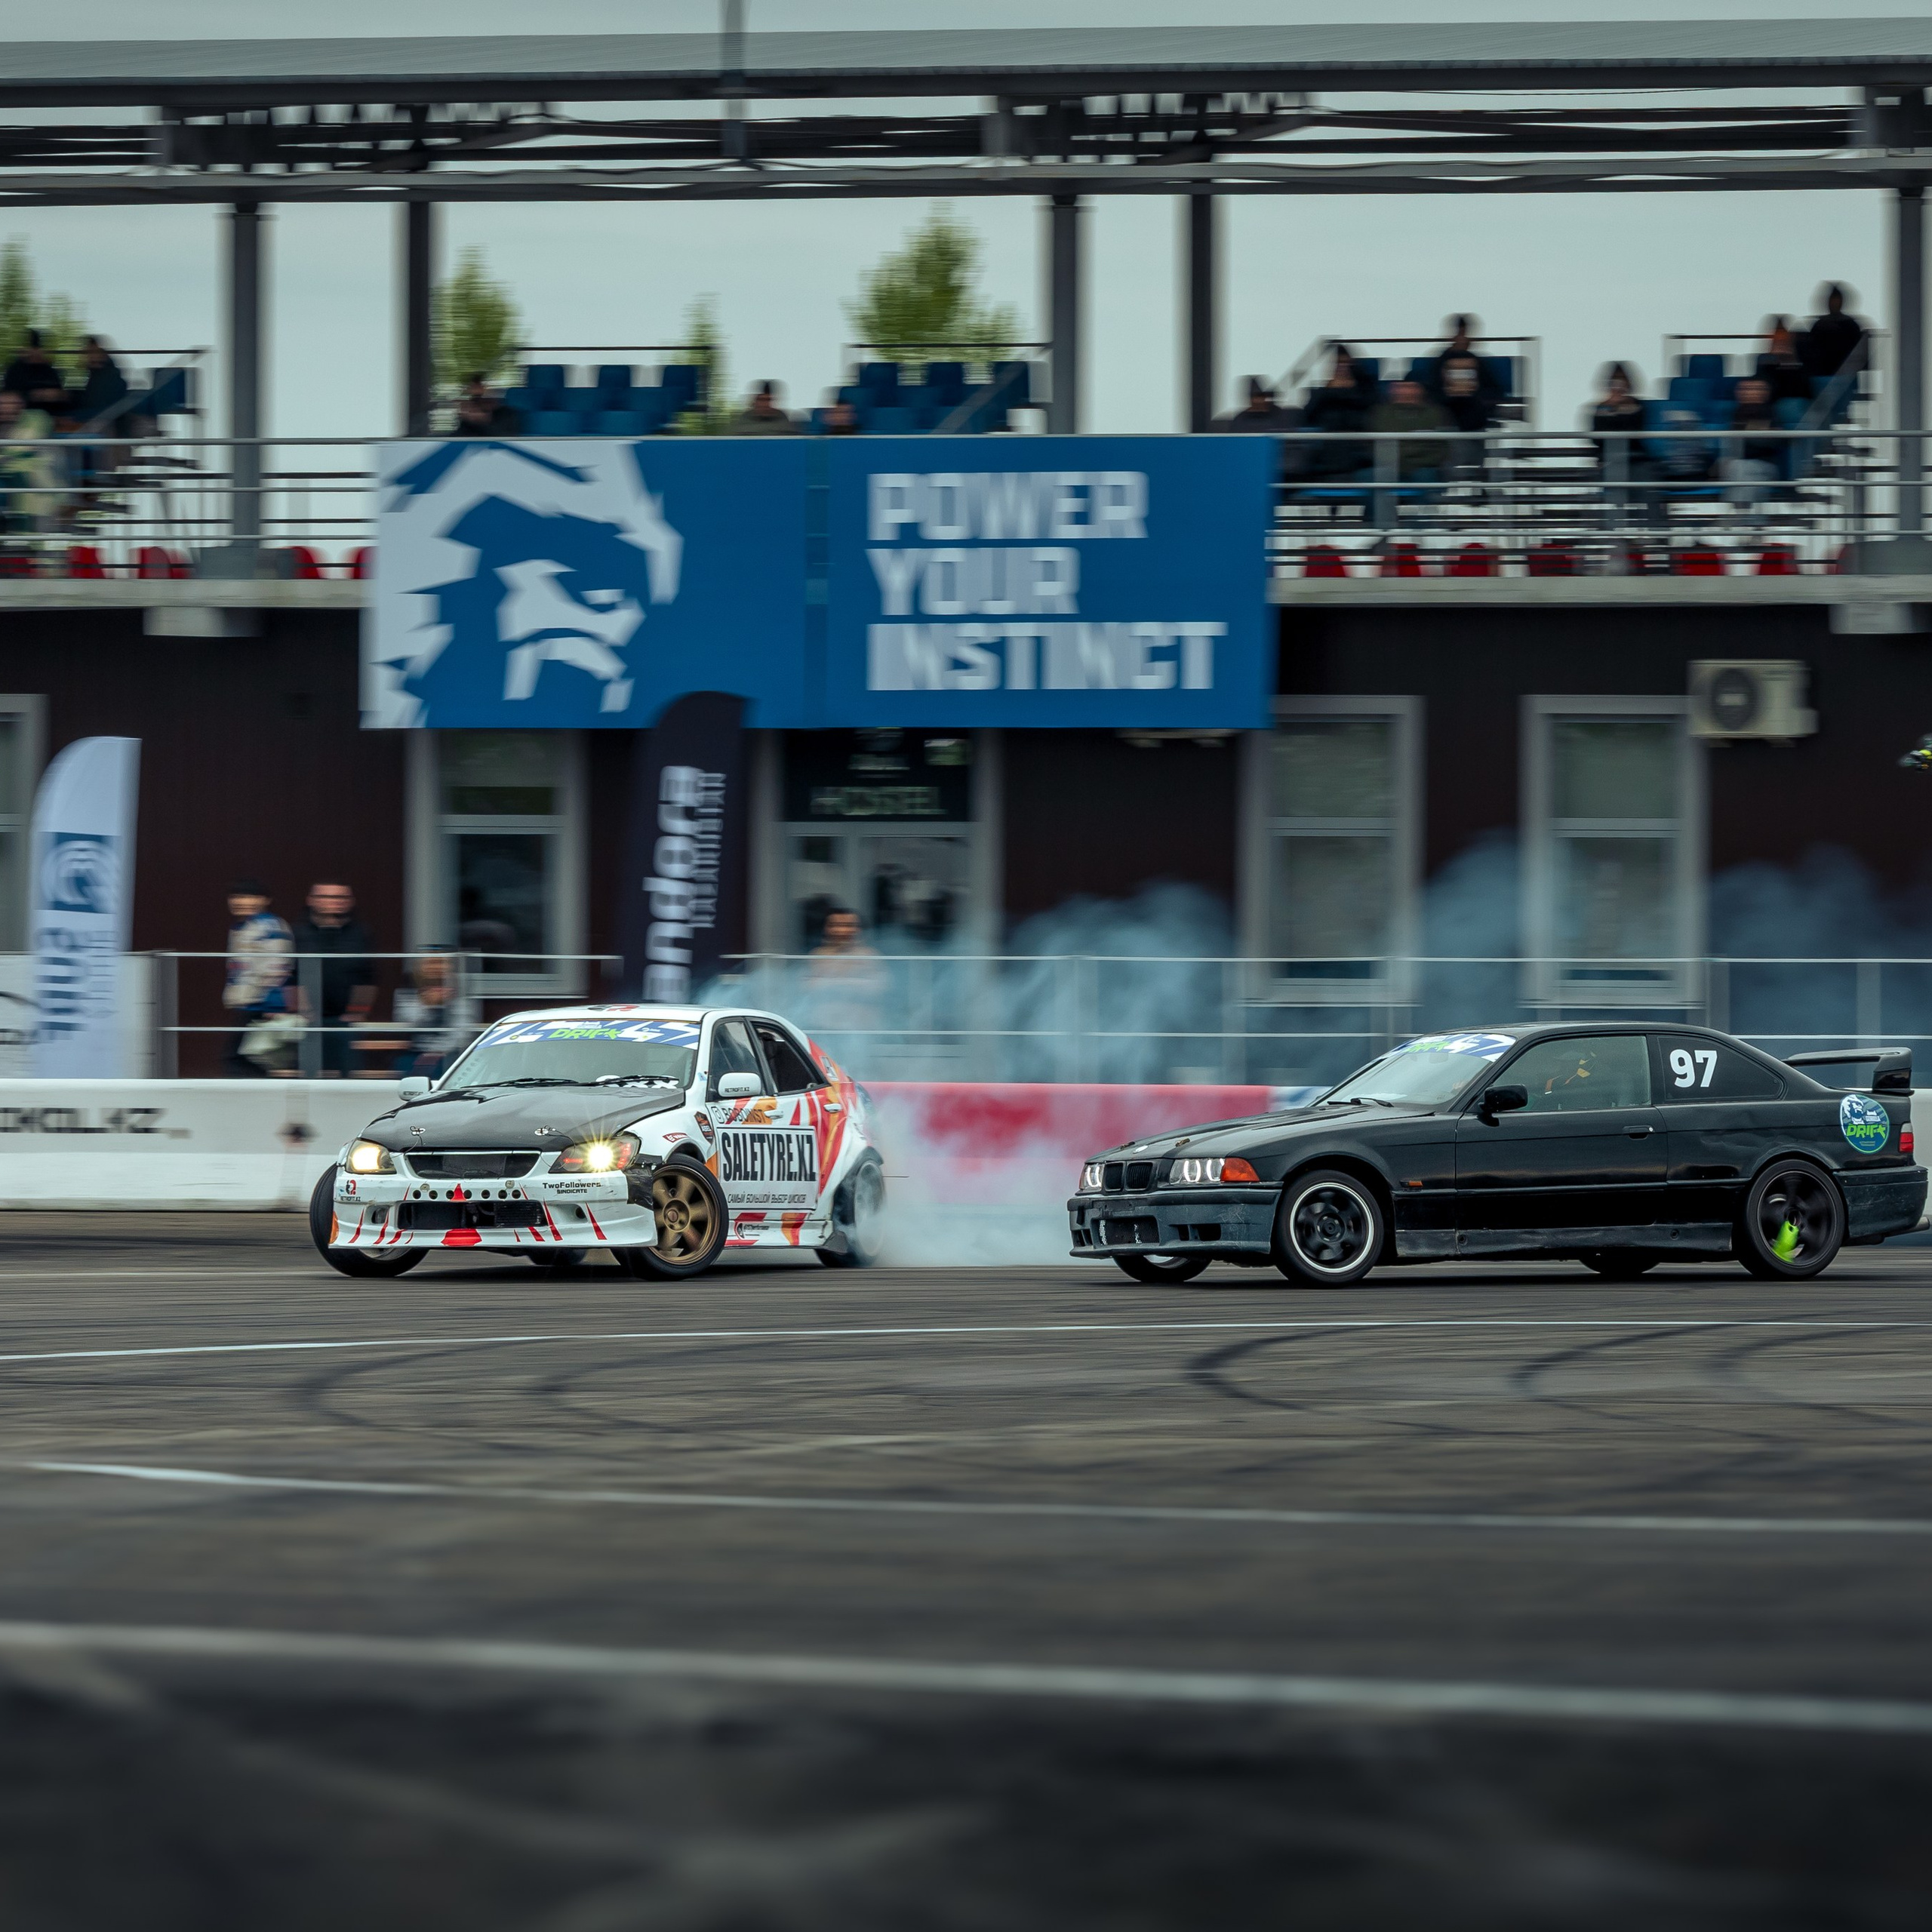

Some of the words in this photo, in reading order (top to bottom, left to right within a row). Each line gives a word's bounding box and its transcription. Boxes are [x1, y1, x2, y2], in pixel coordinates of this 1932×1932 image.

[867, 471, 1149, 540] POWER
[865, 547, 1081, 615] YOUR
[867, 622, 1228, 691] INSTINCT
[1669, 1049, 1718, 1088] 97
[721, 1132, 816, 1182] SALETYRE.KZ
